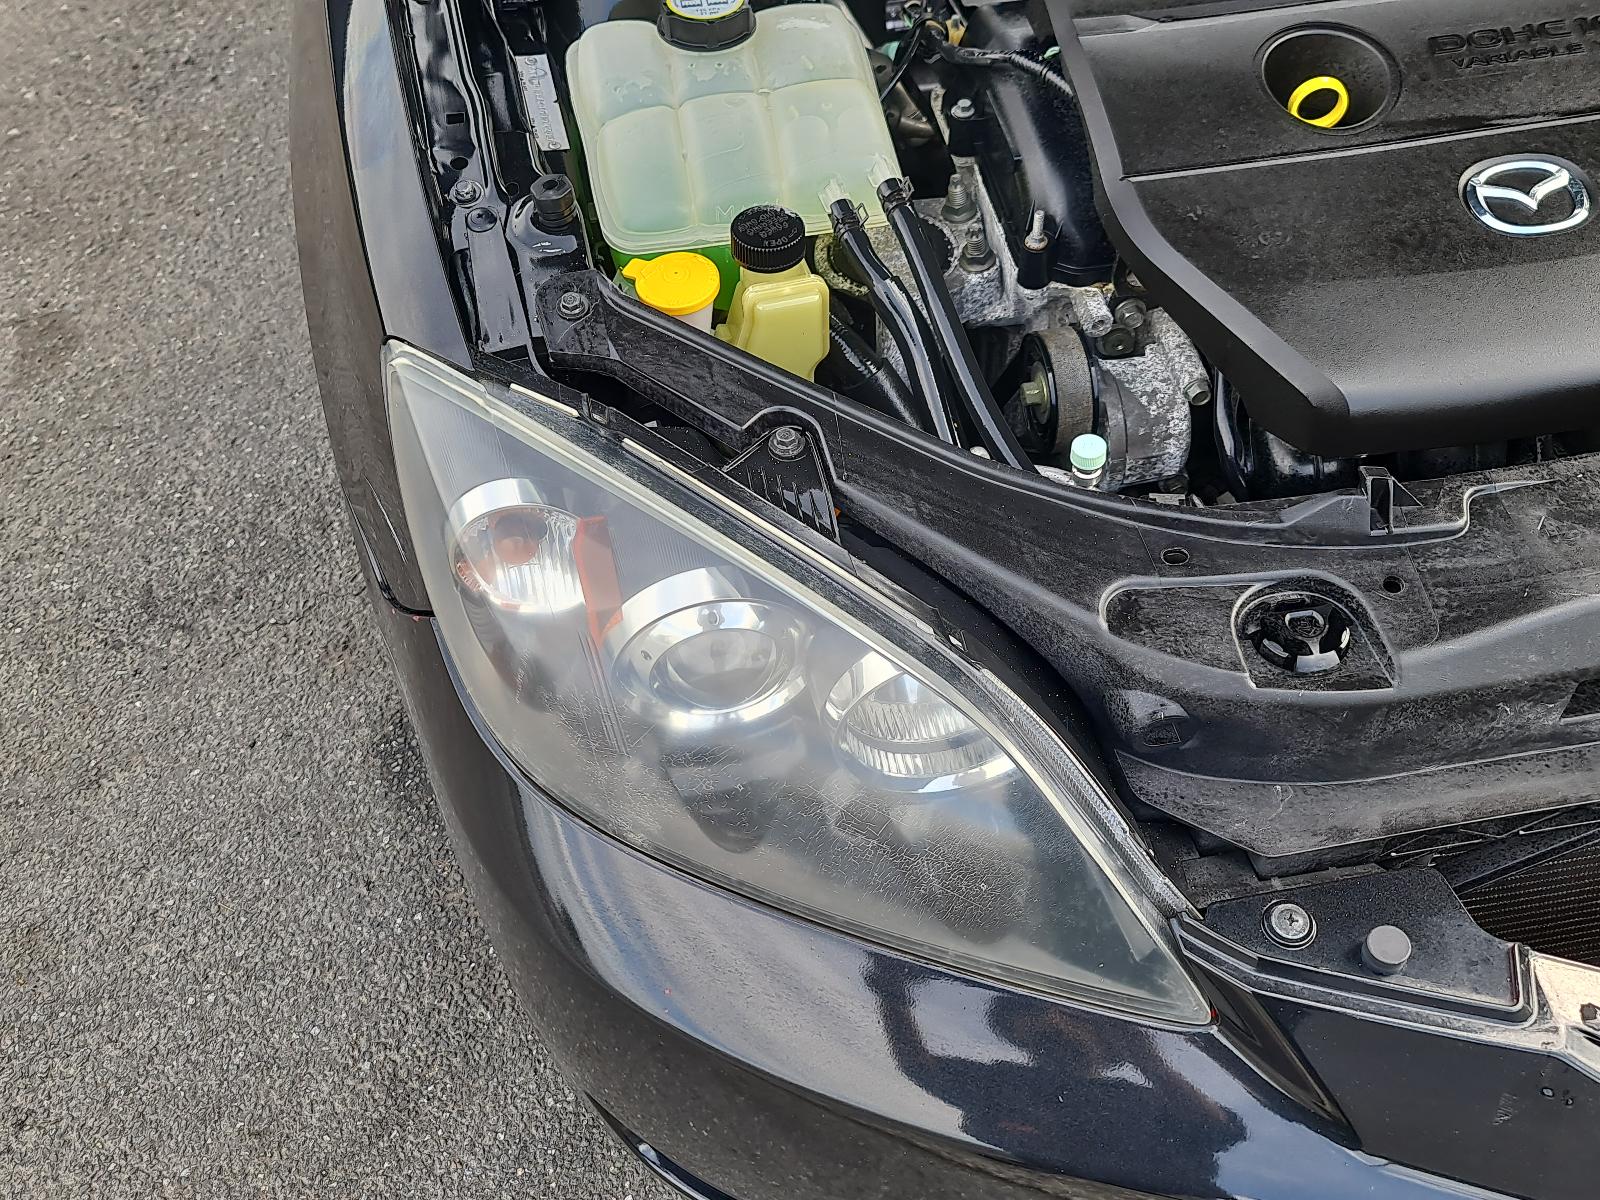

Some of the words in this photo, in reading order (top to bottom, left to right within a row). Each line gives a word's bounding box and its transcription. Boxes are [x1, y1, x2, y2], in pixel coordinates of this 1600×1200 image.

[1427, 19, 1572, 54] DOHC
[1451, 42, 1588, 70] VARIABLE
[759, 221, 789, 239] POWER
[763, 236, 788, 247] OPEN
